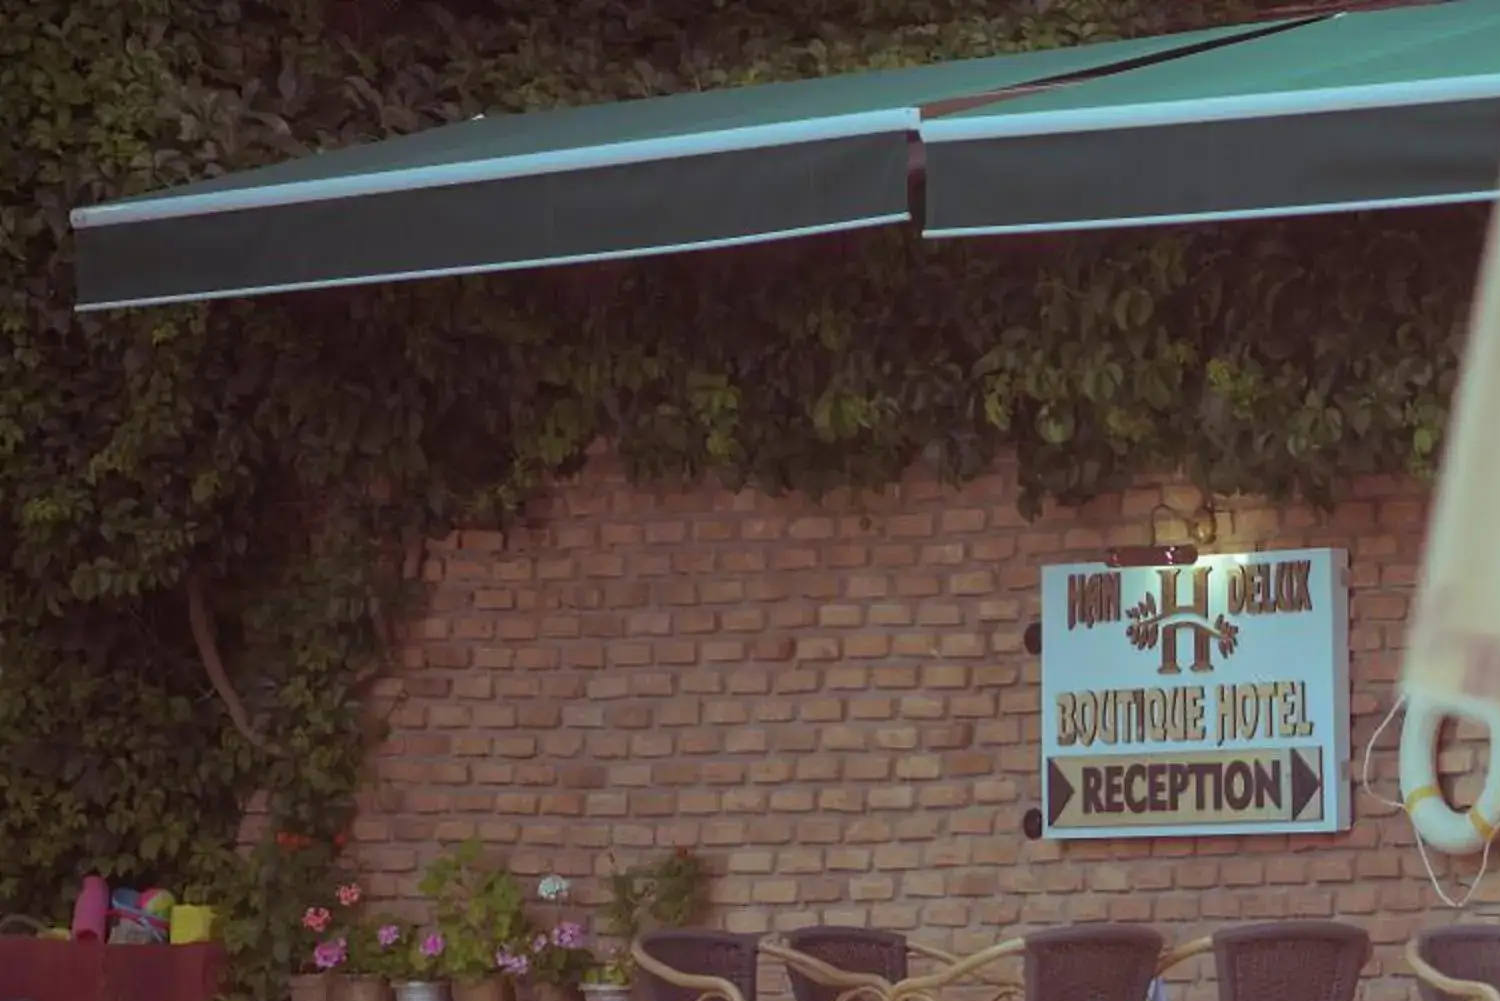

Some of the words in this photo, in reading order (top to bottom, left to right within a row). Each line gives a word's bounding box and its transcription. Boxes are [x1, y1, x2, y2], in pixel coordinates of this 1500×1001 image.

[1228, 560, 1313, 613] DELUX
[1056, 685, 1207, 747] BOUTIQUE
[1216, 681, 1313, 746] HOTEL
[1082, 760, 1282, 814] RECEPTION
